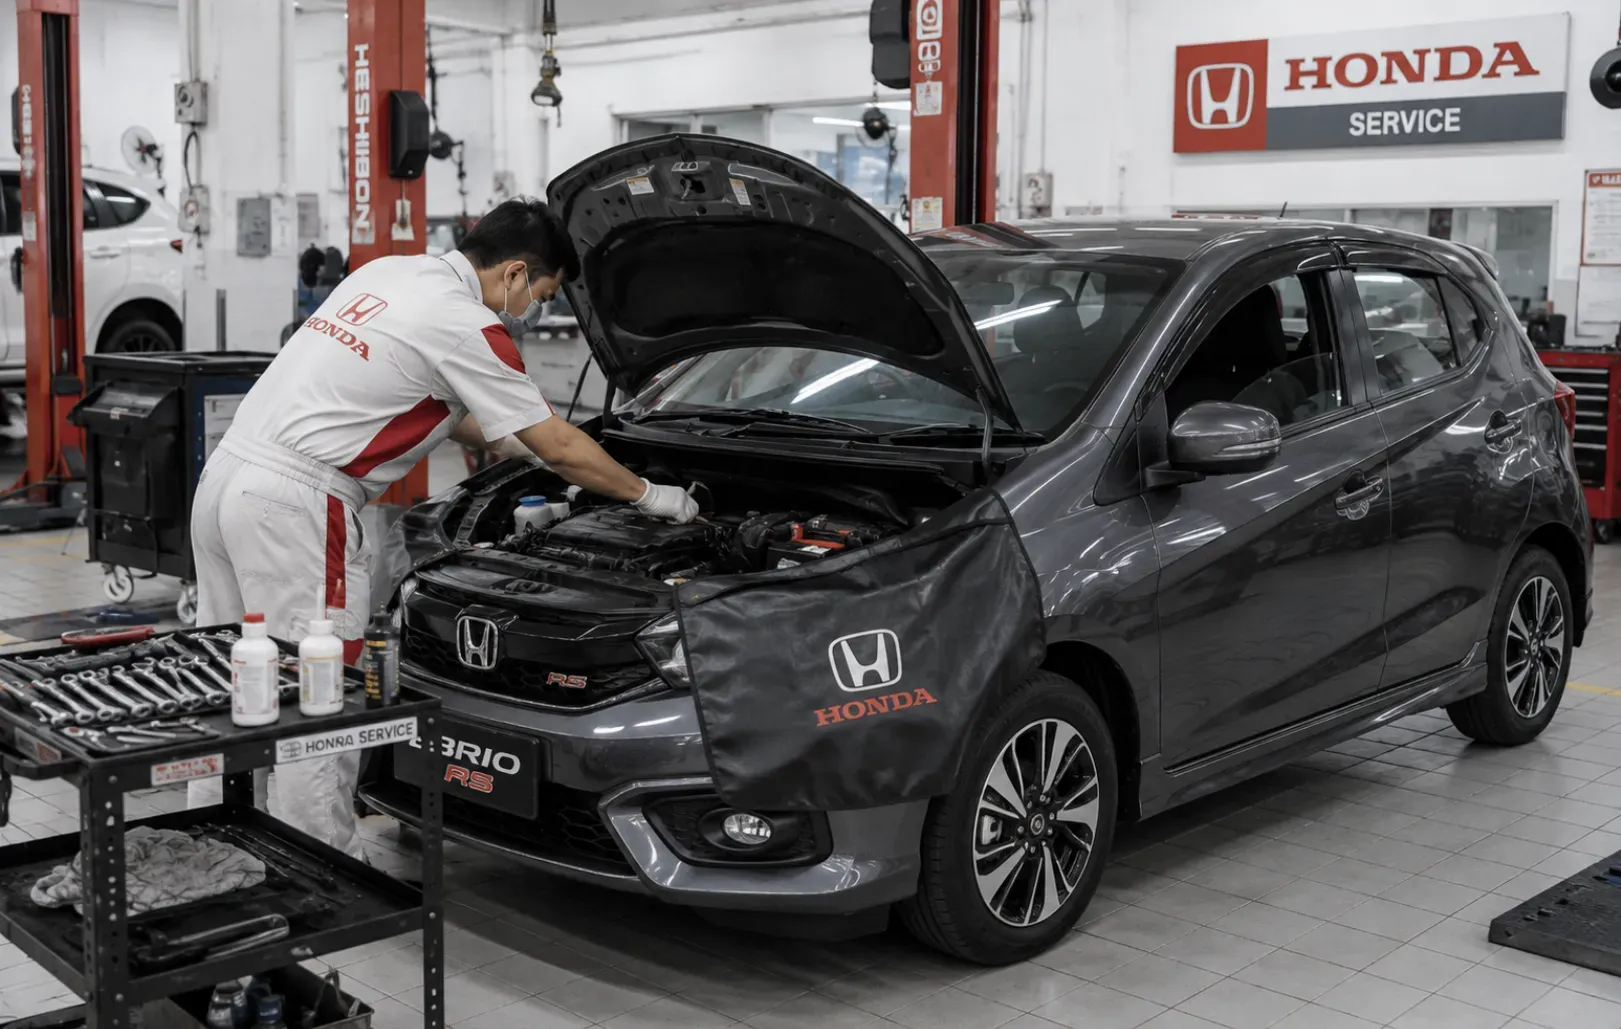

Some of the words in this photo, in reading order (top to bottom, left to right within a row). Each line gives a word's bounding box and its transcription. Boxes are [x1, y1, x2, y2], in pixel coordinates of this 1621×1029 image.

[1284, 41, 1540, 91] HONDA
[1349, 107, 1461, 136] SERVICE
[304, 316, 370, 361] HONDA
[547, 672, 588, 689] RS
[813, 688, 938, 727] HONDA
[358, 721, 414, 745] SERVICE
[444, 763, 494, 794] RS
